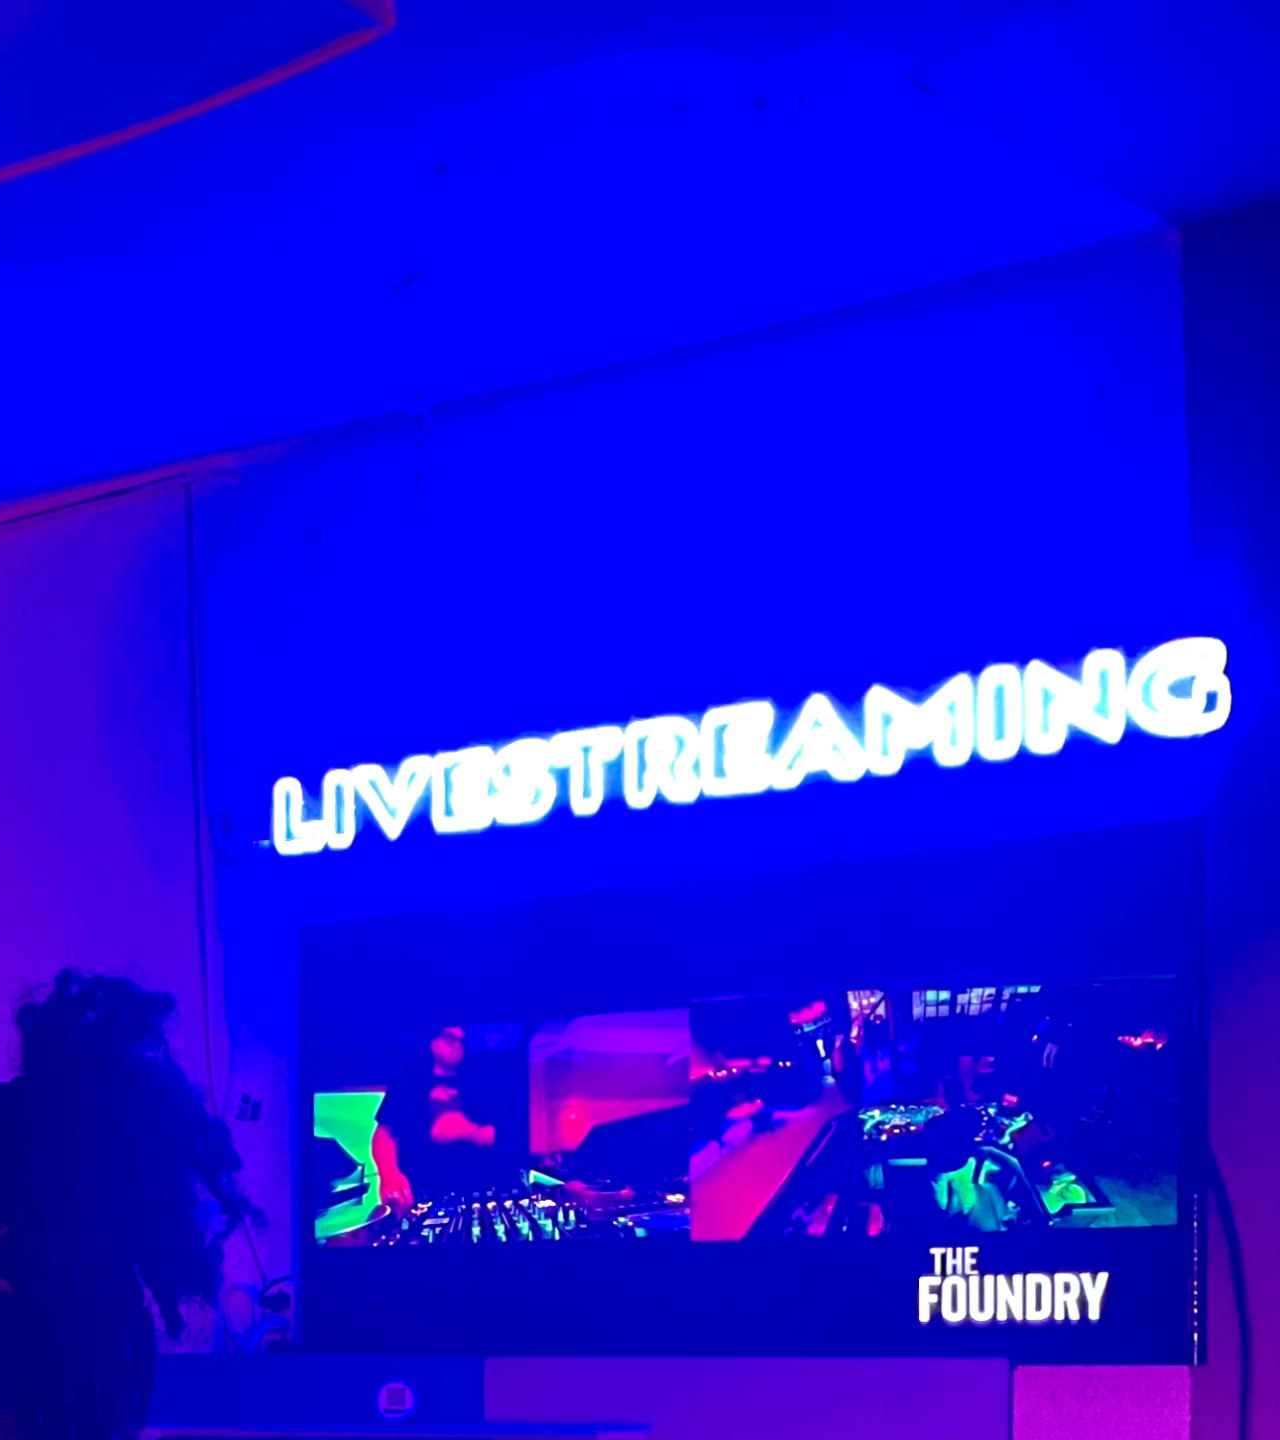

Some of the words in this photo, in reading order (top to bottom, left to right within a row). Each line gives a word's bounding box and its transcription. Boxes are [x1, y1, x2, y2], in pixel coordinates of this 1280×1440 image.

[271, 636, 1232, 856] LIVESTREAMING
[929, 1246, 979, 1275] THE
[918, 1272, 1110, 1323] FOUNDRY
